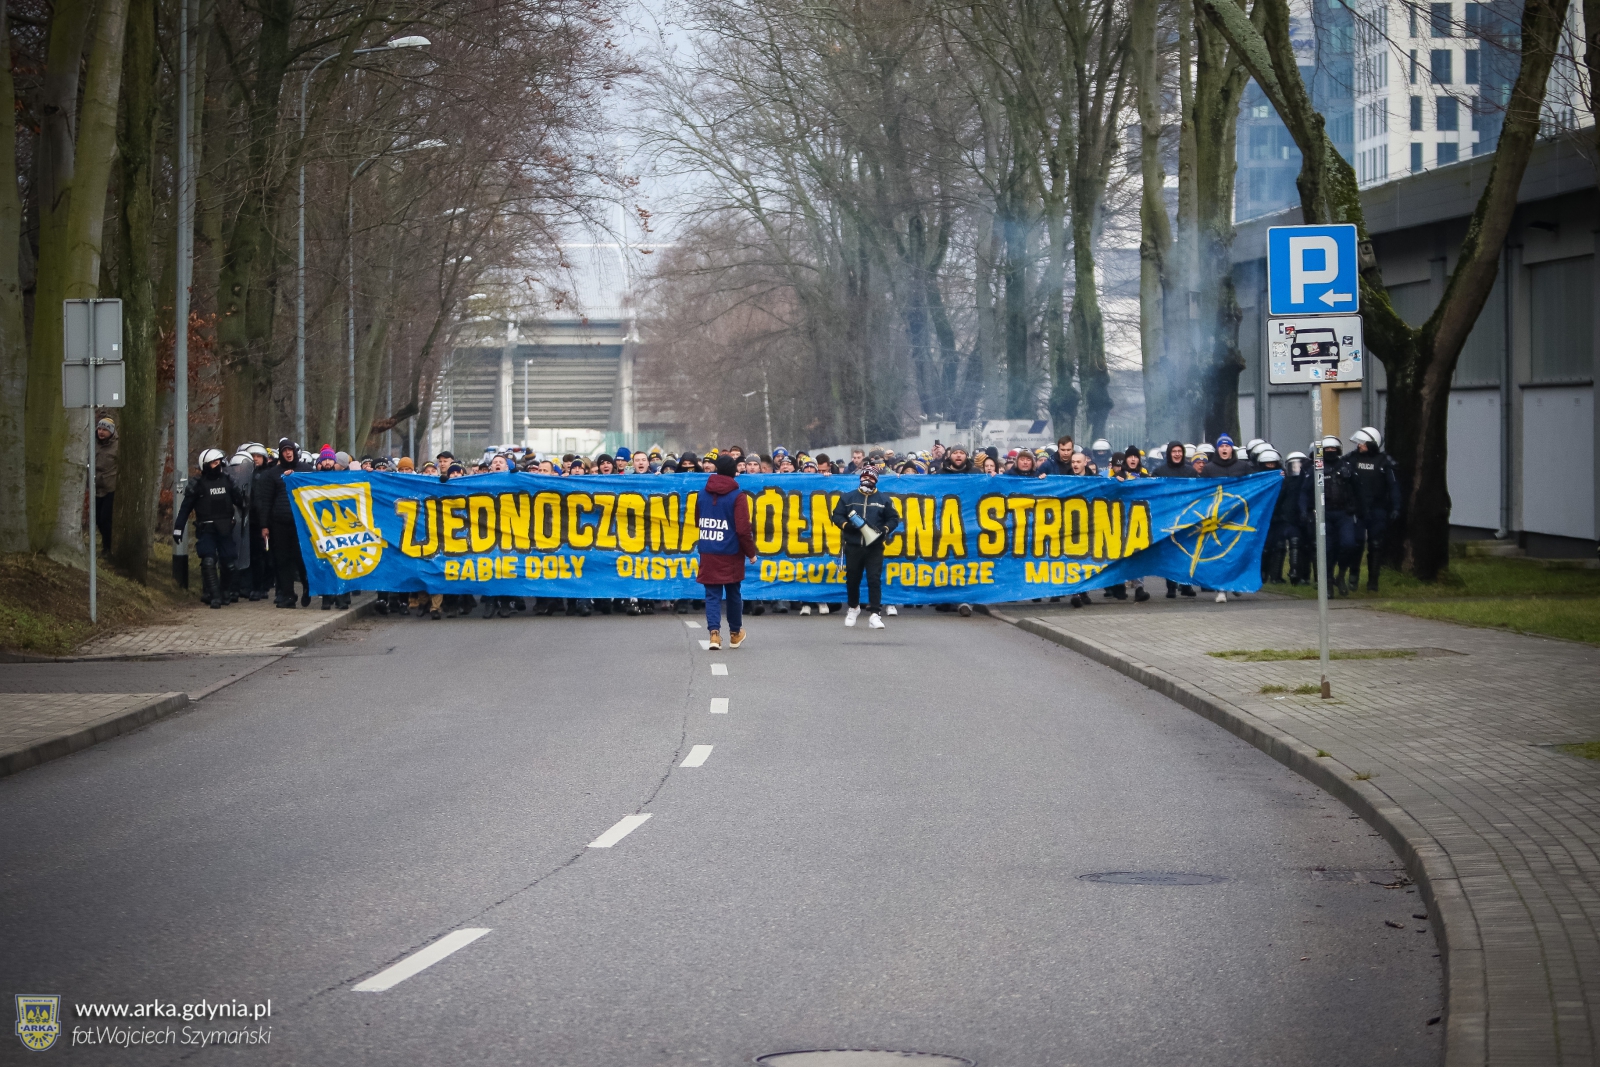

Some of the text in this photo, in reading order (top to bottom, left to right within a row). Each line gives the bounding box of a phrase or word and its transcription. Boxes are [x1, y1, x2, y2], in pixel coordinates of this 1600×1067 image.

[1289, 236, 1339, 304] P
[209, 487, 226, 495] POLICJA
[699, 529, 725, 541] KLUB
[978, 495, 1150, 559] STRONA
[325, 531, 374, 552] ARKA
[444, 556, 519, 582] BABIE
[524, 555, 586, 580] DOŁY
[616, 555, 700, 580] OKSYW
[886, 561, 995, 587] POGÓRZE
